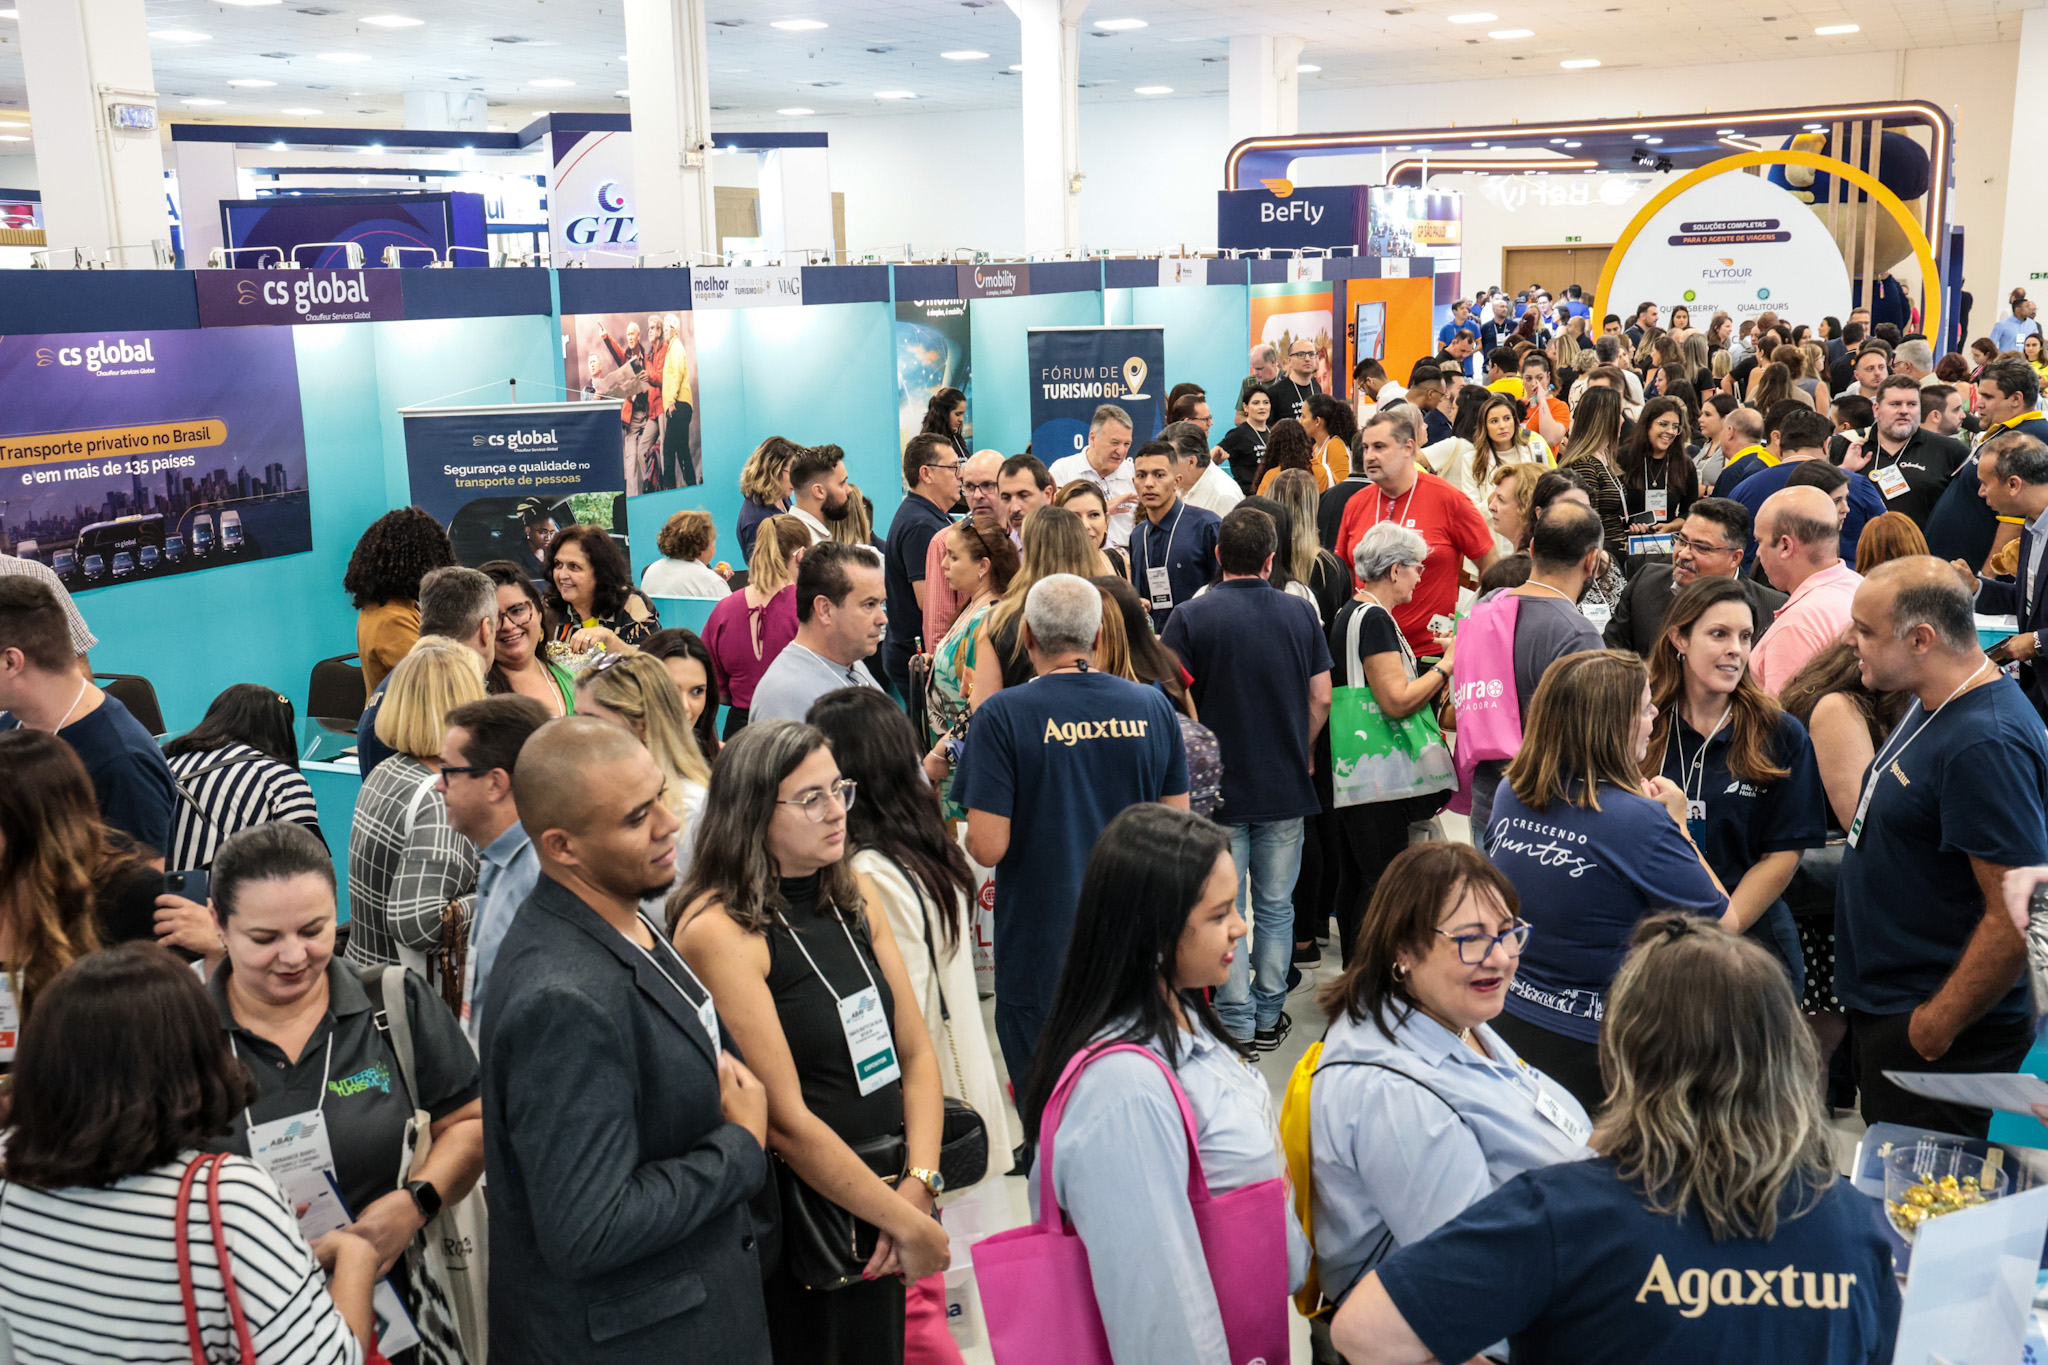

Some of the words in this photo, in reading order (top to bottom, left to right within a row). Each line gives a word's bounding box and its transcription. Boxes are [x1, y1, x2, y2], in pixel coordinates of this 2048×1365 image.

[1260, 201, 1324, 225] BeFly
[1693, 222, 1726, 231] SOLUÇÕES
[1727, 221, 1766, 229] COMPLETAS
[1746, 233, 1776, 241] VIAGENS
[985, 269, 1017, 291] mobility
[1702, 268, 1752, 278] FLYTOUR
[694, 276, 729, 291] melhor
[735, 287, 756, 295] TURISMO
[263, 280, 290, 306] cs
[294, 271, 370, 314] global
[695, 292, 716, 301] viagem
[305, 313, 331, 321] Chauffeur
[332, 312, 353, 320] Services
[354, 311, 371, 319] Global
[1737, 303, 1789, 312] QUALITOURS
[58, 347, 82, 366] cs
[85, 338, 154, 372] global
[1042, 365, 1095, 380] FÓRUM
[1100, 366, 1118, 379] DE
[1042, 382, 1102, 399] TURISMO
[1103, 382, 1128, 398] 60+
[0, 441, 82, 461] Transporte
[87, 434, 149, 455] privativo
[153, 433, 170, 446] no
[173, 426, 211, 443] Brasil
[488, 434, 505, 446] cs
[508, 429, 558, 450] global
[22, 473, 32, 485] e
[35, 470, 62, 484] em
[64, 463, 100, 480] mais
[102, 460, 122, 476] de
[124, 459, 149, 475] 135
[152, 453, 196, 474] países
[443, 464, 507, 477] Segurança
[509, 464, 516, 472] e
[518, 460, 577, 475] qualidade
[579, 462, 590, 470] no
[455, 477, 515, 489] transporte
[517, 475, 532, 485] de
[535, 474, 581, 486] pessoas
[1043, 717, 1148, 746] Agaxtur
[1512, 818, 1588, 844] CRESCENDO
[1490, 817, 1598, 878] Juntos
[1634, 1253, 1857, 1318] Agaxtur
